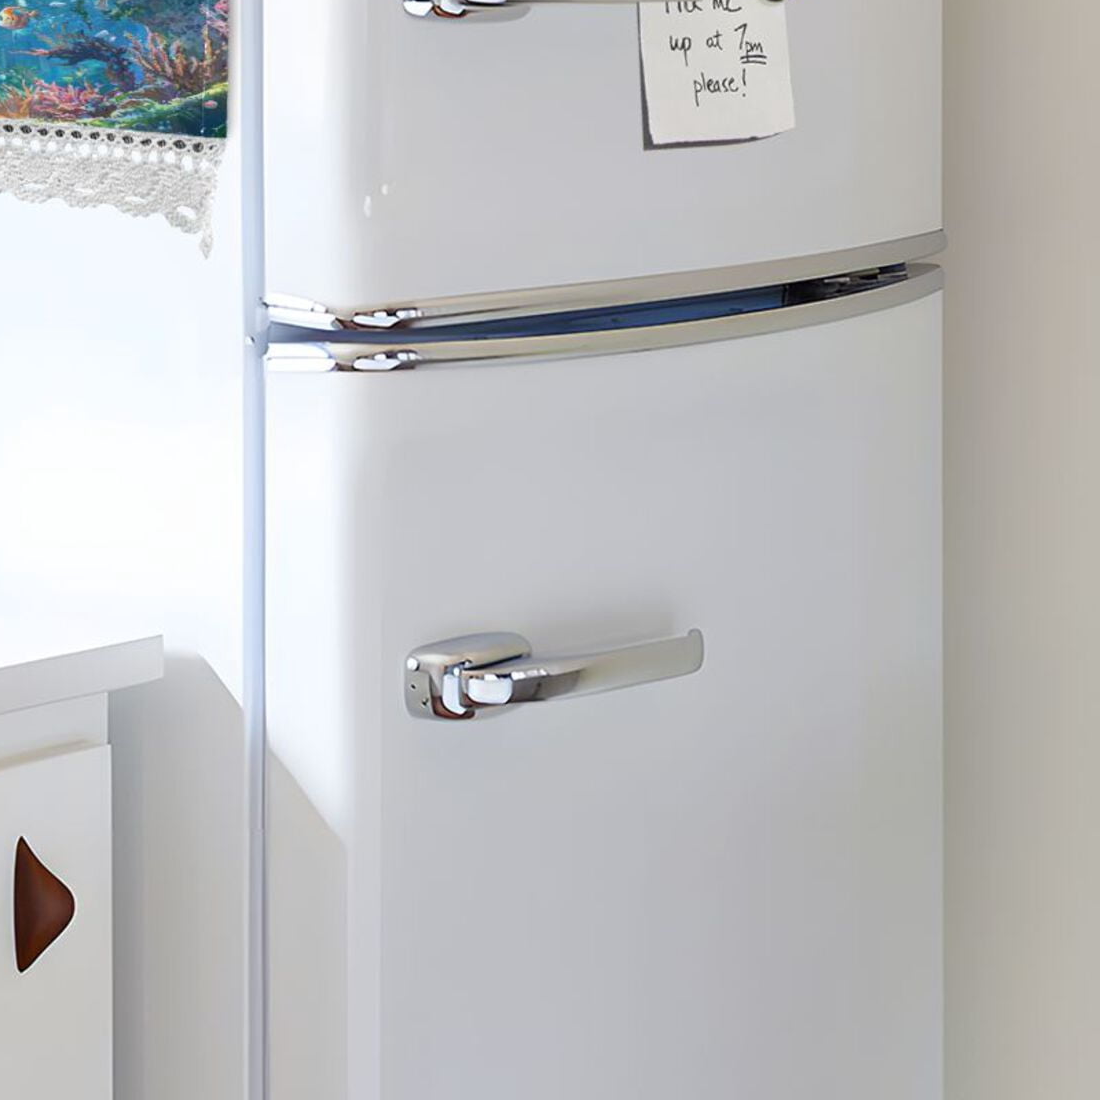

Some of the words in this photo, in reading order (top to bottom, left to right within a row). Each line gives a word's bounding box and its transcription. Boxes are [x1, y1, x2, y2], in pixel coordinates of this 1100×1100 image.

[669, 35, 692, 67] up
[706, 29, 723, 51] at
[693, 68, 747, 107] please!
